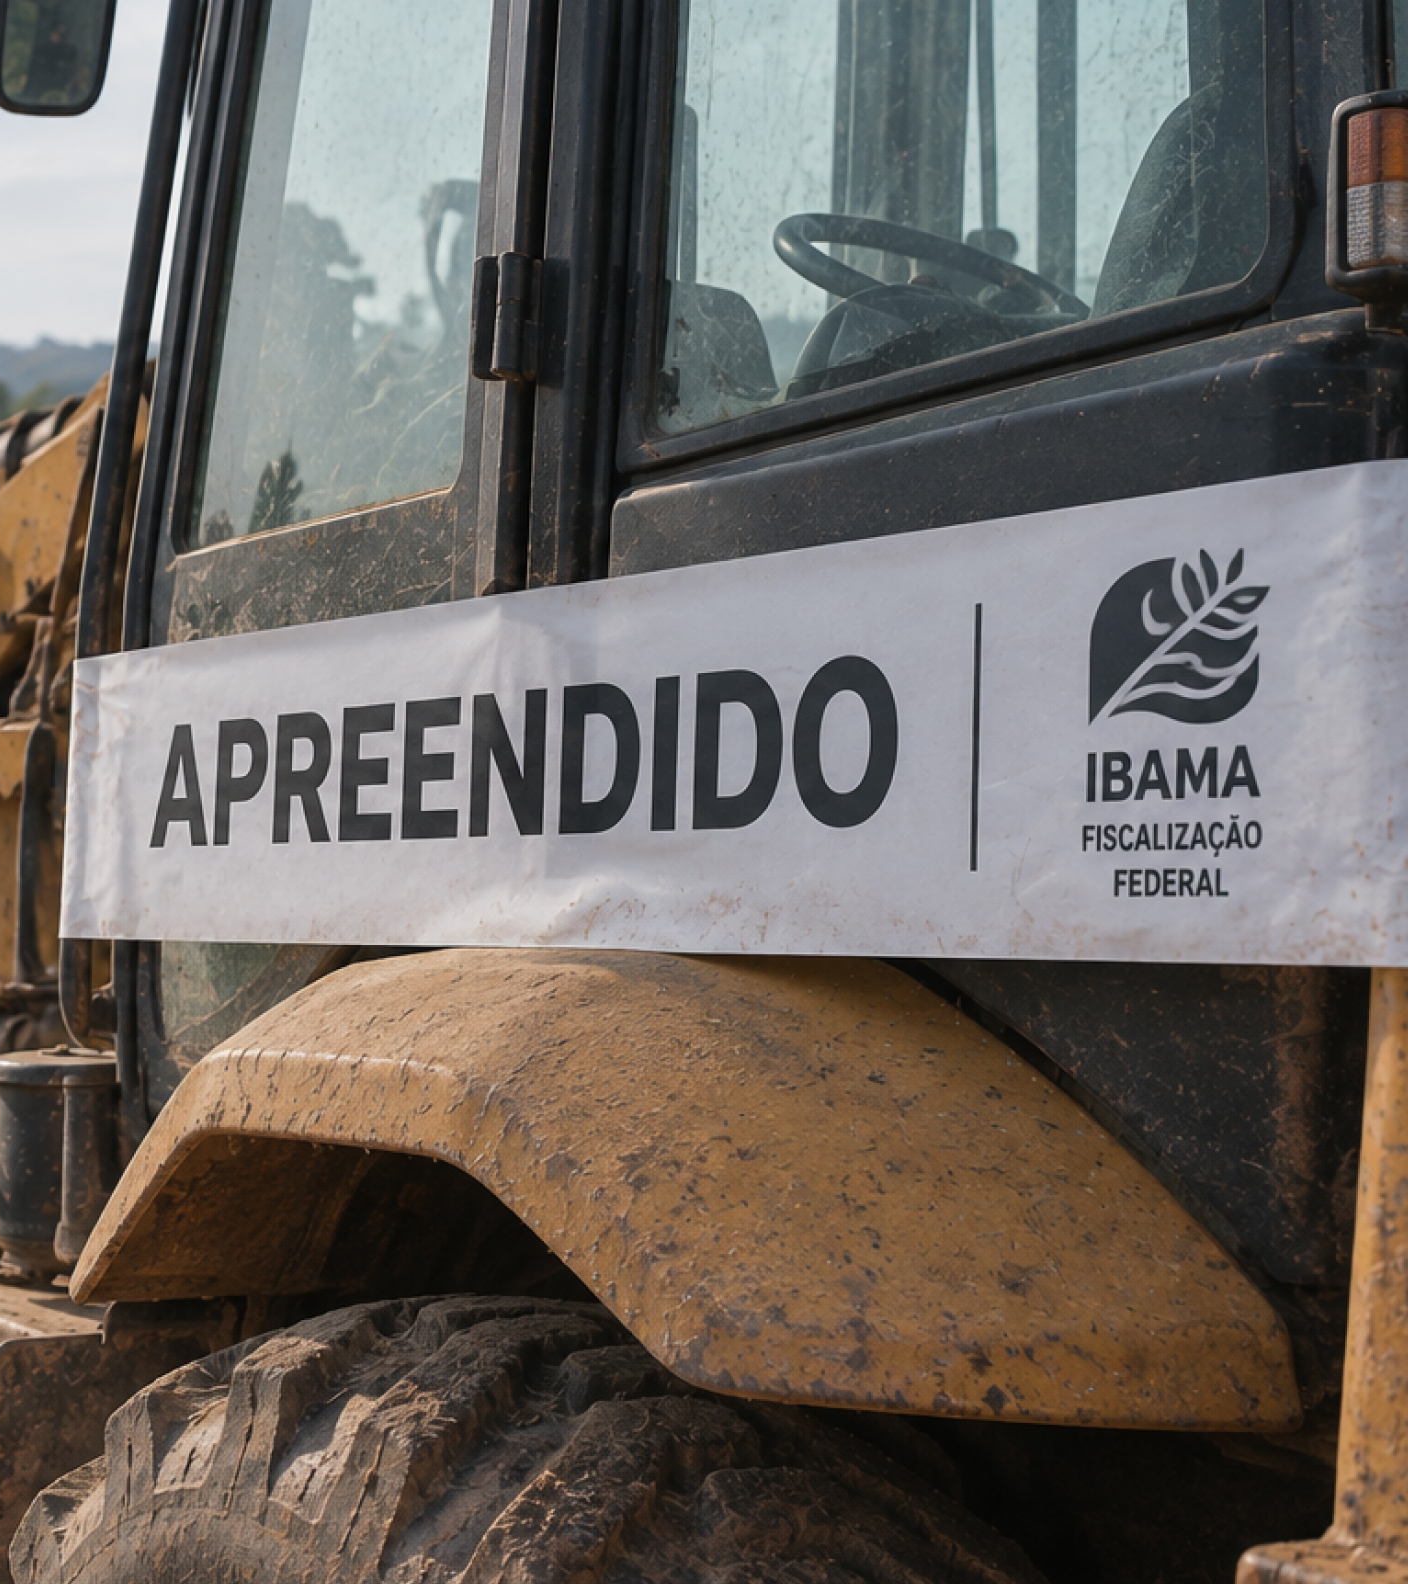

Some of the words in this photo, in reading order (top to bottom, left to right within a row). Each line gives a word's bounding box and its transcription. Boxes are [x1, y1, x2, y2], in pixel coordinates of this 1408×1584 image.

[150, 654, 899, 848] APREENDIDO
[1085, 744, 1261, 803] IBAMA
[1113, 867, 1229, 898] FEDERAL
